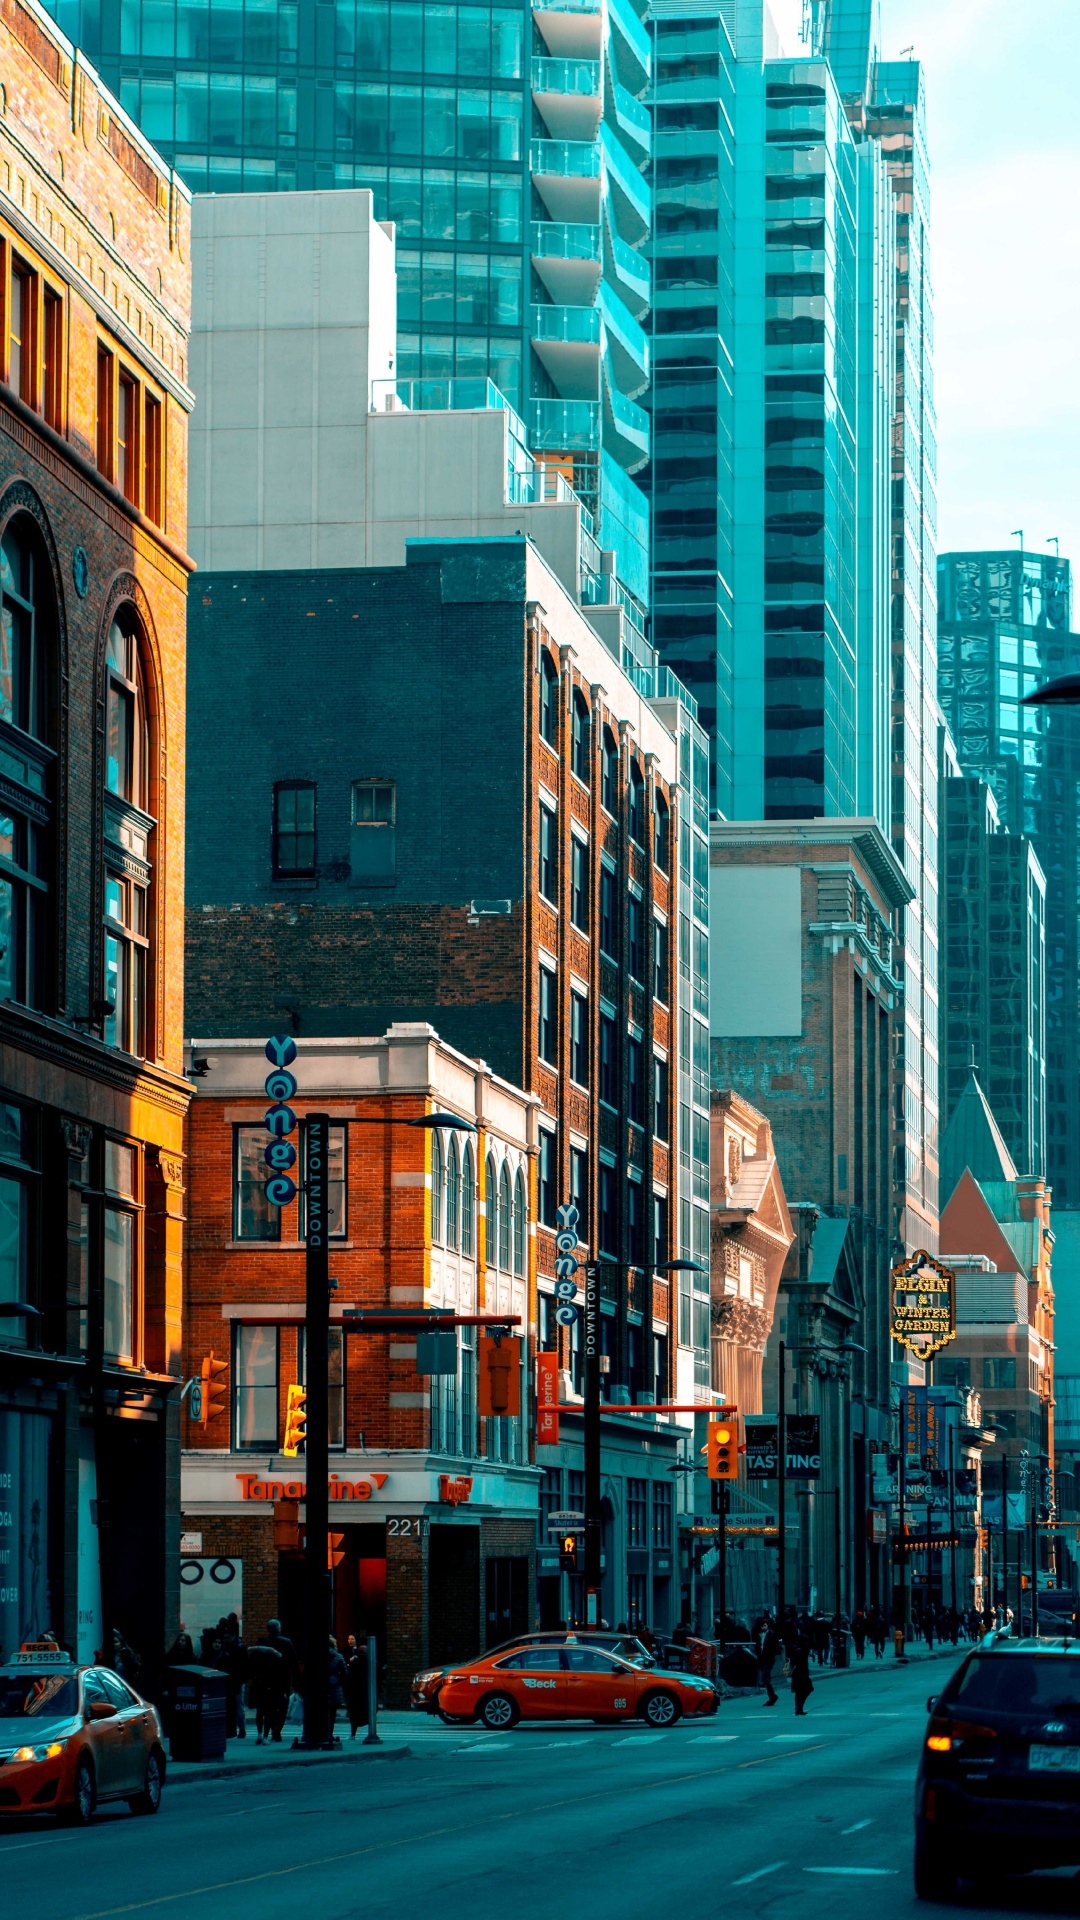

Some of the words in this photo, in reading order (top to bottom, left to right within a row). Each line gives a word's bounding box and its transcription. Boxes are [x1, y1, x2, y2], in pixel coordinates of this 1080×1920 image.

[265, 1035, 297, 1206] Yonge
[309, 1122, 322, 1247] DOWNTOWN
[554, 1204, 579, 1326] Yonge
[894, 1276, 950, 1293] ELGIN
[918, 1293, 928, 1305] &
[587, 1267, 597, 1356] DOWNTOWN
[894, 1306, 950, 1319] WINTER
[894, 1320, 950, 1332] GARDEN
[735, 1516, 764, 1525] Suites
[388, 1518, 421, 1537] 221
[26, 1644, 50, 1652] BECK
[16, 1653, 62, 1663] 751-5555
[527, 1678, 557, 1689] Beck
[182, 1702, 198, 1711] Litter
[614, 1698, 627, 1709] 695
